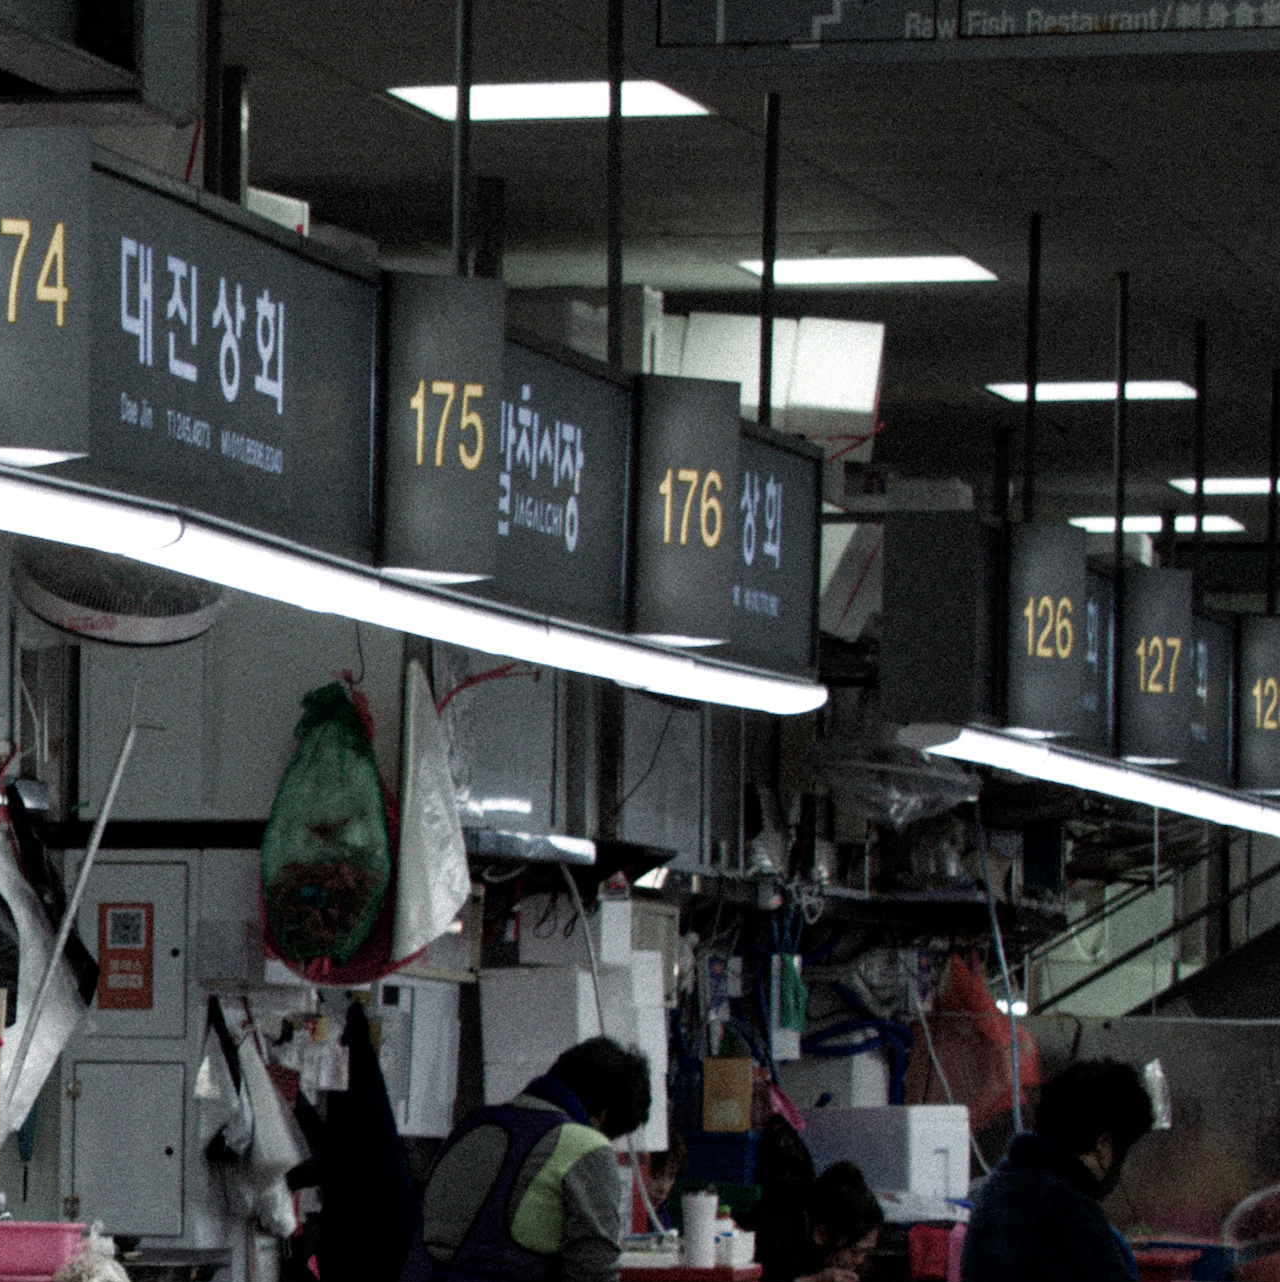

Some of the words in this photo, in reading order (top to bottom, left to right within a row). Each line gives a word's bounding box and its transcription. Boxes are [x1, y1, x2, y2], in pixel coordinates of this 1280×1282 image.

[967, 8, 1017, 37] Fish
[121, 235, 284, 416] 대진상회
[410, 378, 485, 472] 175
[658, 466, 723, 549] 176
[1023, 594, 1074, 660] 126
[1135, 634, 1182, 694] 127
[1252, 676, 1280, 730] 12
